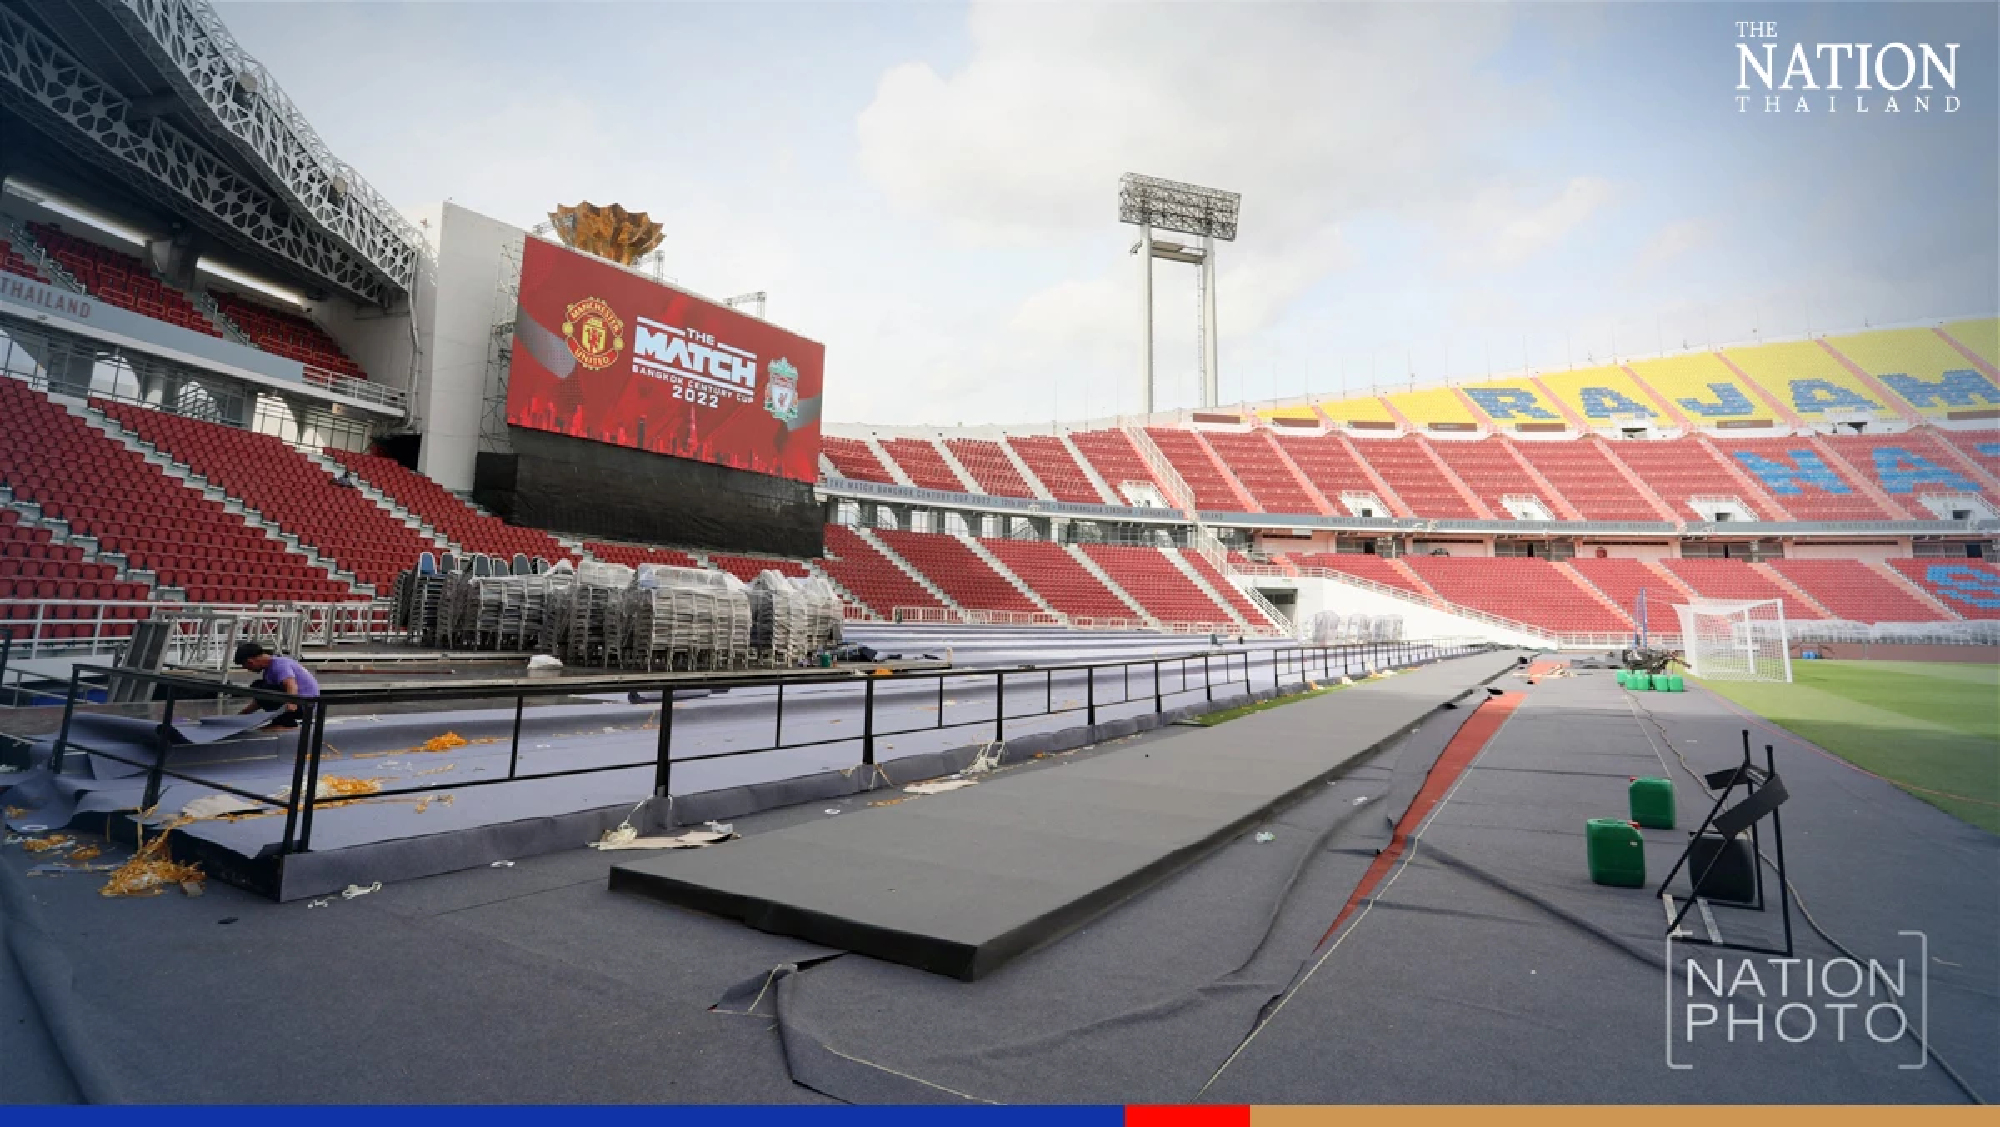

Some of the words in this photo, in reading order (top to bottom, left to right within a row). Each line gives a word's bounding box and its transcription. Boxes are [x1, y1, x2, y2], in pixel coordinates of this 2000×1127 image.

[1, 277, 91, 318] THAILAND
[687, 327, 715, 346] THE
[633, 325, 757, 388] MATCH
[632, 364, 683, 385] BANGKOK
[687, 379, 732, 399] CENTURY
[736, 391, 754, 404] CUP
[672, 384, 718, 408] 2022
[829, 479, 844, 489] THE
[847, 481, 874, 493] MATCH
